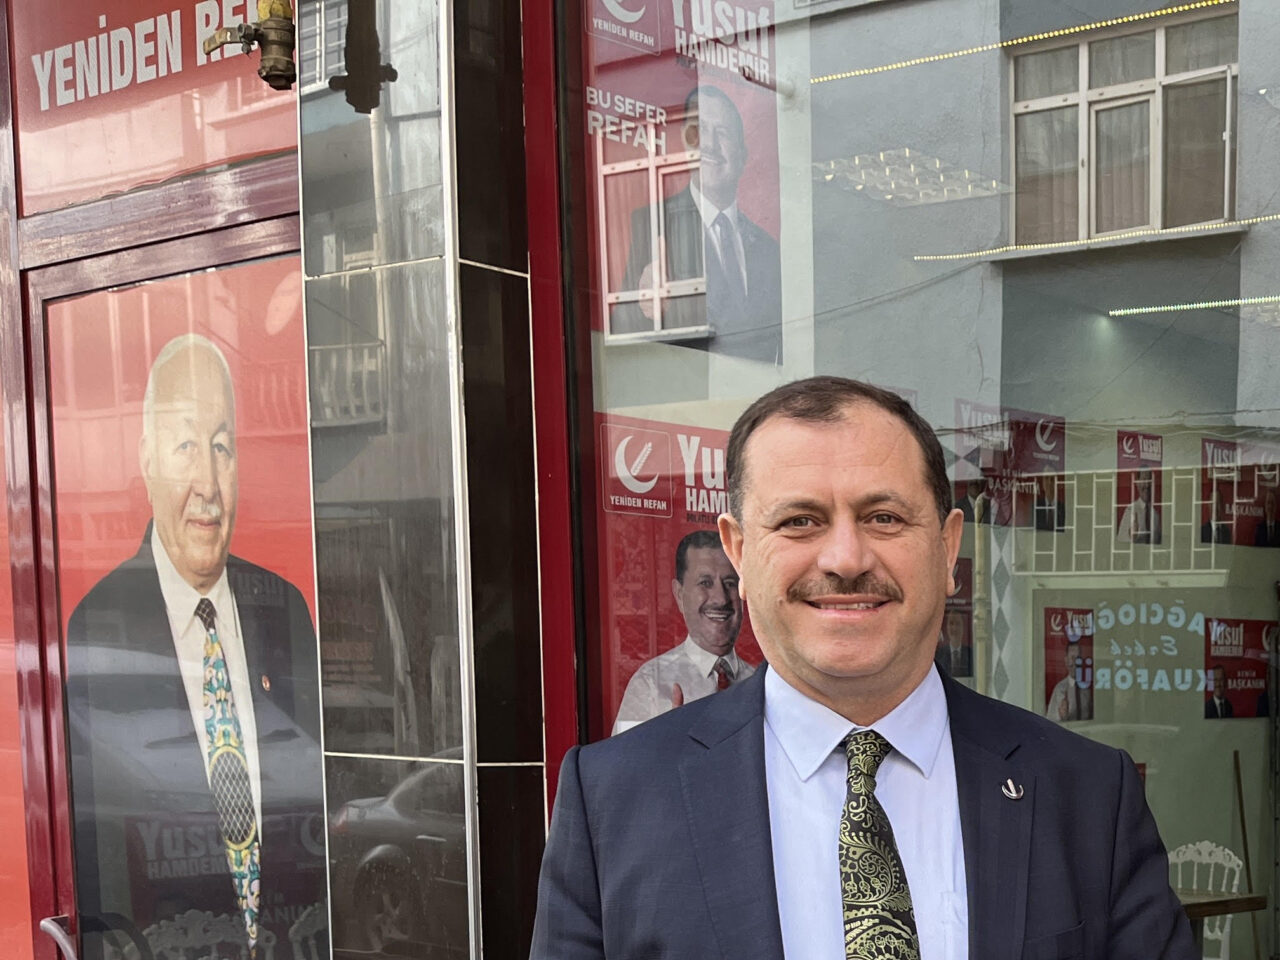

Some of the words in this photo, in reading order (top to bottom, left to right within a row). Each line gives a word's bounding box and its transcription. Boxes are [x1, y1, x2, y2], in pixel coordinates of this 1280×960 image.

[592, 17, 627, 38] YENİDEN
[628, 29, 655, 47] REFAH
[32, 10, 182, 111] YENİDEN
[674, 28, 770, 85] HAMDEMİR
[586, 86, 611, 109] BU
[614, 95, 668, 127] SEFER
[586, 110, 667, 156] REFAH
[609, 495, 642, 509] YENİDEN
[643, 498, 668, 511] REFAH
